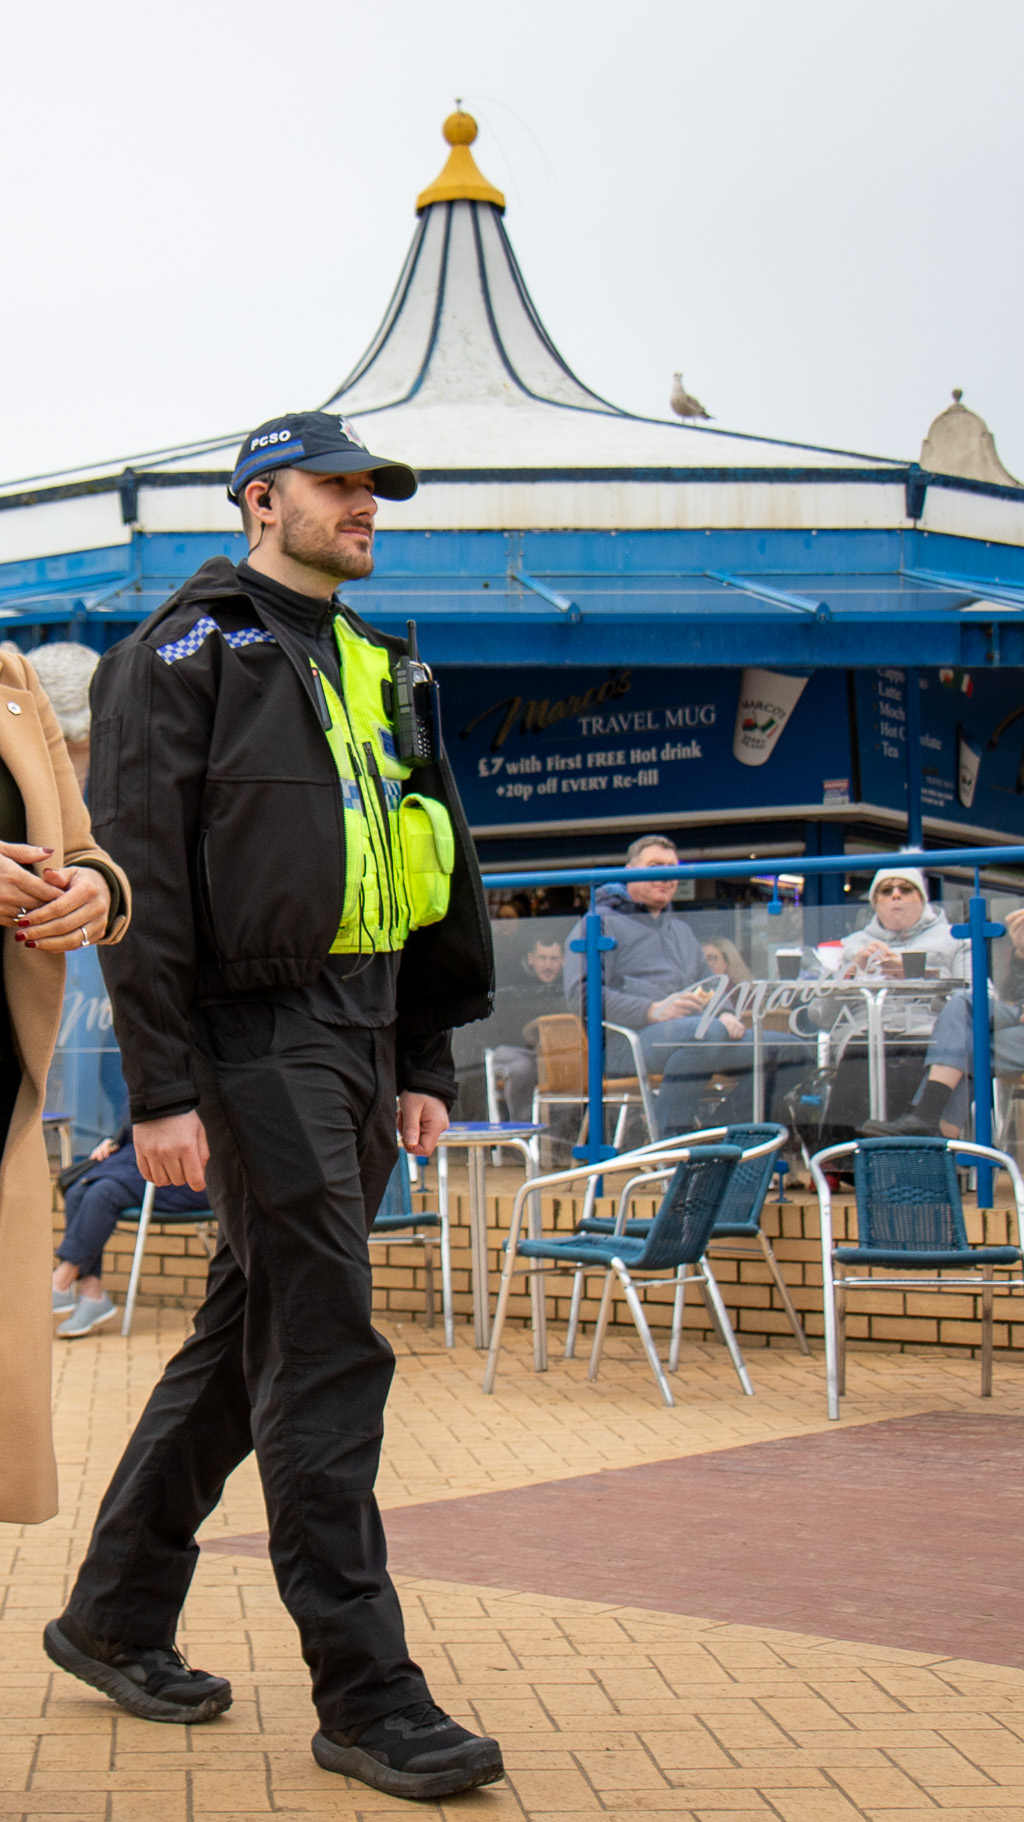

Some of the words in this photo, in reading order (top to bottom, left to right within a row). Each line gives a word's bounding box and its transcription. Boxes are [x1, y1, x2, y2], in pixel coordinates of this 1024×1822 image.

[250, 429, 291, 451] PCSO
[578, 707, 659, 737] TRAVEL
[665, 704, 716, 729] MUG
[879, 700, 906, 721] Moch
[880, 721, 898, 739] Hot
[478, 756, 505, 778] £7
[505, 754, 542, 776] with
[546, 752, 582, 772] First
[587, 750, 627, 768] FREE
[630, 747, 658, 765] Hot
[660, 739, 702, 762] drink
[495, 783, 533, 802] +20p
[537, 777, 558, 796] off
[561, 775, 609, 793] EVERY
[613, 768, 660, 789] Re-fill
